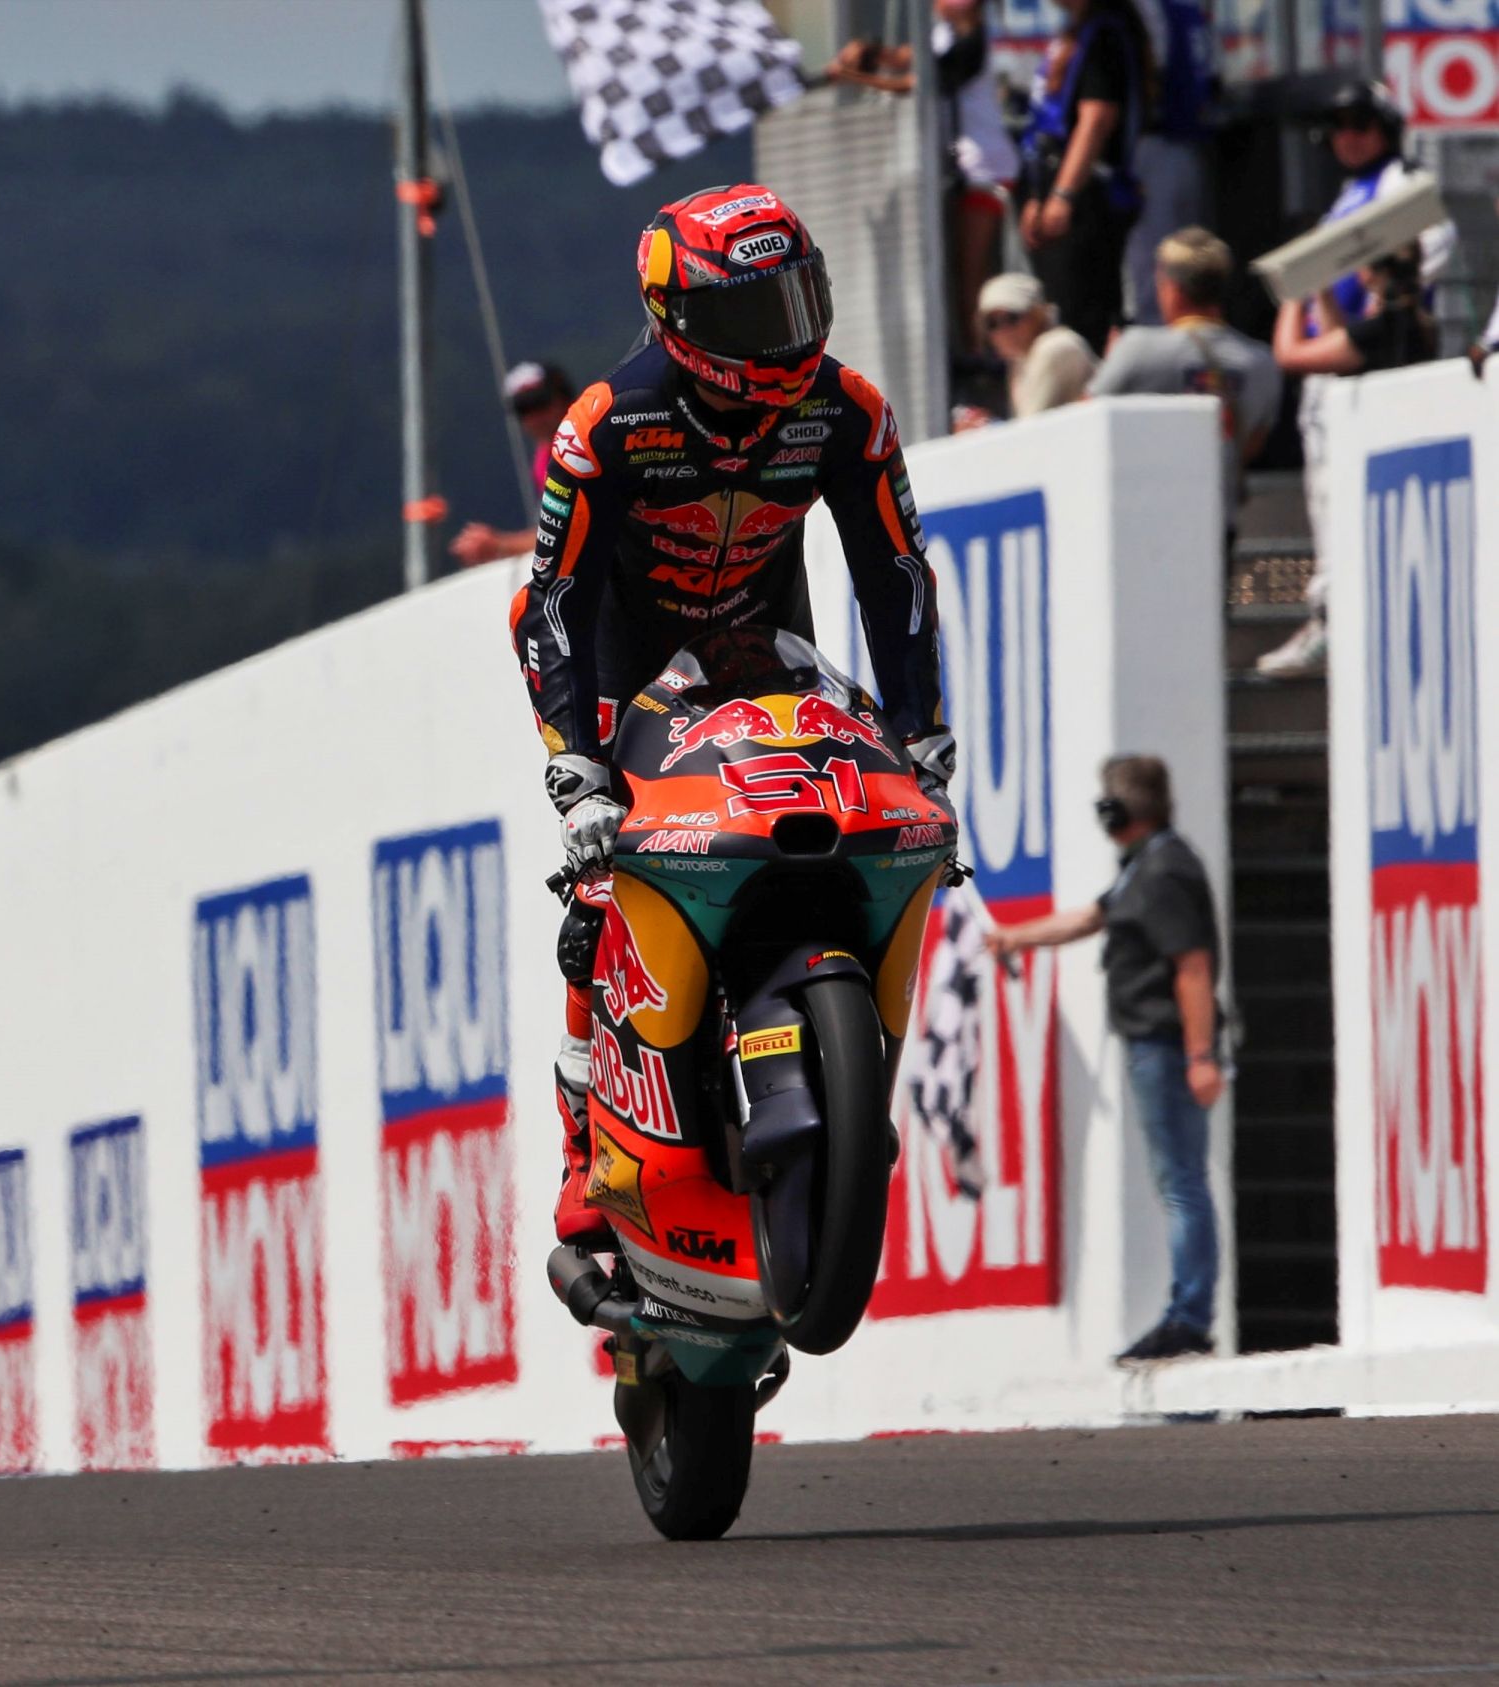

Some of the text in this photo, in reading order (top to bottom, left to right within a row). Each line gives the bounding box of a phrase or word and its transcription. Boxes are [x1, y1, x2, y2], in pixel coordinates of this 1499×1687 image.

[738, 236, 785, 260] SHOEI
[721, 272, 757, 288] GIVES
[762, 265, 785, 277] YOU
[664, 334, 741, 392] Red Bull
[624, 427, 685, 452] KTM
[787, 426, 823, 440] SHOEI
[767, 446, 822, 466] AVANT
[652, 534, 785, 567] Red Bull
[1369, 475, 1477, 853] LIQUI
[658, 669, 690, 690] WRS
[718, 753, 868, 818] 51
[636, 829, 715, 854] AVANT
[894, 823, 944, 851] AVANT
[664, 858, 730, 872] MOTOREX
[374, 843, 509, 1095] LIQUI
[200, 898, 317, 1143] LIQUI
[743, 1031, 793, 1056] PIRELLI
[601, 1022, 683, 1141] Bull
[1374, 895, 1485, 1256] MOLY
[666, 1226, 736, 1266] KTM
[642, 1297, 704, 1326] NAUTICAL
